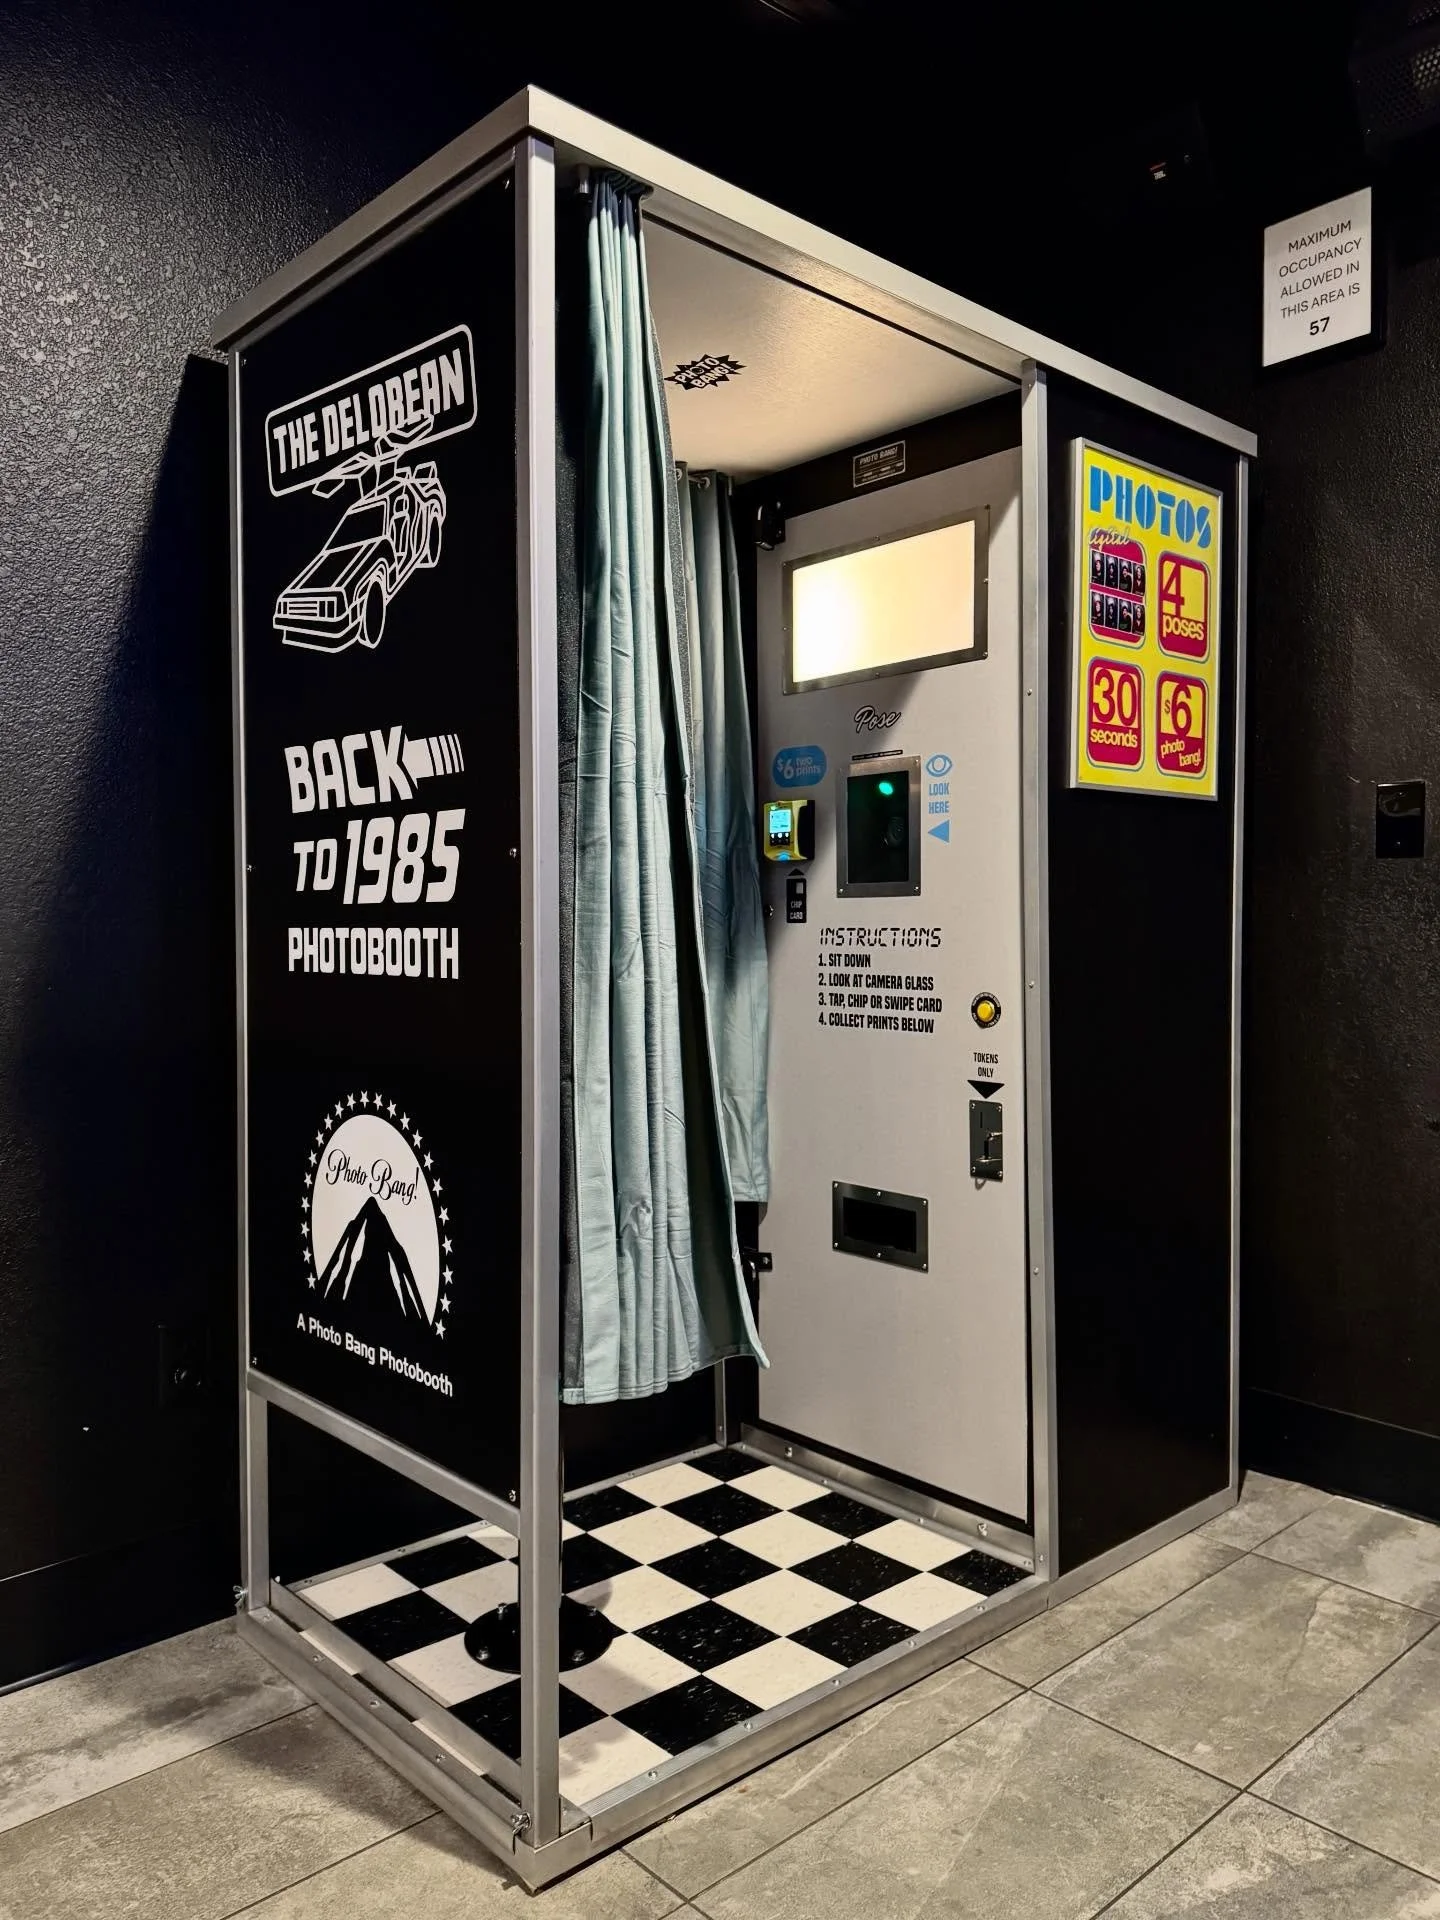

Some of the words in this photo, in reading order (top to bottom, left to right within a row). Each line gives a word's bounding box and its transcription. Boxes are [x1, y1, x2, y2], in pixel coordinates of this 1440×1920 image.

[1288, 220, 1351, 253] MAXIMUM
[1279, 237, 1362, 278] OCCUPANCY
[1280, 266, 1343, 299] ALLOWED
[1347, 260, 1360, 276] IN
[1280, 300, 1309, 319] THIS
[1311, 288, 1345, 309] AREA
[1349, 282, 1361, 297] IS
[1309, 316, 1331, 336] 57
[674, 357, 721, 383] PHOTO
[690, 362, 736, 388] BANG!
[273, 412, 320, 475] THE
[321, 348, 466, 457] DELOREAN
[1090, 465, 1212, 549] PHOTOS
[1162, 561, 1185, 616] 4
[1162, 614, 1205, 641] poses
[1093, 668, 1137, 727] 30
[1163, 682, 1193, 736] $6
[854, 705, 902, 733] Pose
[1090, 728, 1138, 748] seconds
[1160, 738, 1186, 758] photo
[284, 725, 413, 813] BACK
[776, 757, 795, 780] $6
[1178, 748, 1202, 767] bang!
[795, 765, 821, 778] prints
[928, 782, 950, 796] LOOK
[928, 801, 950, 815] HERE
[293, 838, 338, 892] TO
[343, 808, 466, 905] 1985
[789, 911, 804, 920] CARD
[790, 900, 803, 909] CHIP
[820, 927, 943, 948] INSTRUCTIONS
[287, 927, 459, 980] PHOTOBOOTH
[818, 953, 827, 967] 1.
[828, 953, 842, 968] SIT
[844, 953, 871, 968] DOWN
[818, 973, 827, 987] 2.
[828, 973, 851, 988] LOOK
[852, 974, 864, 988] AT
[865, 974, 903, 990] CAMERA
[905, 975, 934, 991] GLASS
[818, 992, 827, 1006] 3.
[829, 992, 846, 1010] TAP,
[847, 994, 869, 1009] CHIP
[870, 995, 883, 1009] OR
[884, 995, 915, 1011] SWIPE
[916, 997, 943, 1013] CARD
[818, 1011, 827, 1026] 4.
[828, 1012, 865, 1029] COLLECT
[866, 1015, 900, 1031] PRINTS
[901, 1017, 935, 1034] BELOW
[973, 1051, 999, 1065] TOKENS
[977, 1066, 994, 1078] ONLY
[325, 1148, 368, 1186] Photo
[368, 1158, 419, 1206] Bang!
[297, 1313, 306, 1332] A
[309, 1316, 342, 1347] Photo
[345, 1332, 376, 1366] Bang
[379, 1346, 453, 1397] Photobooth
